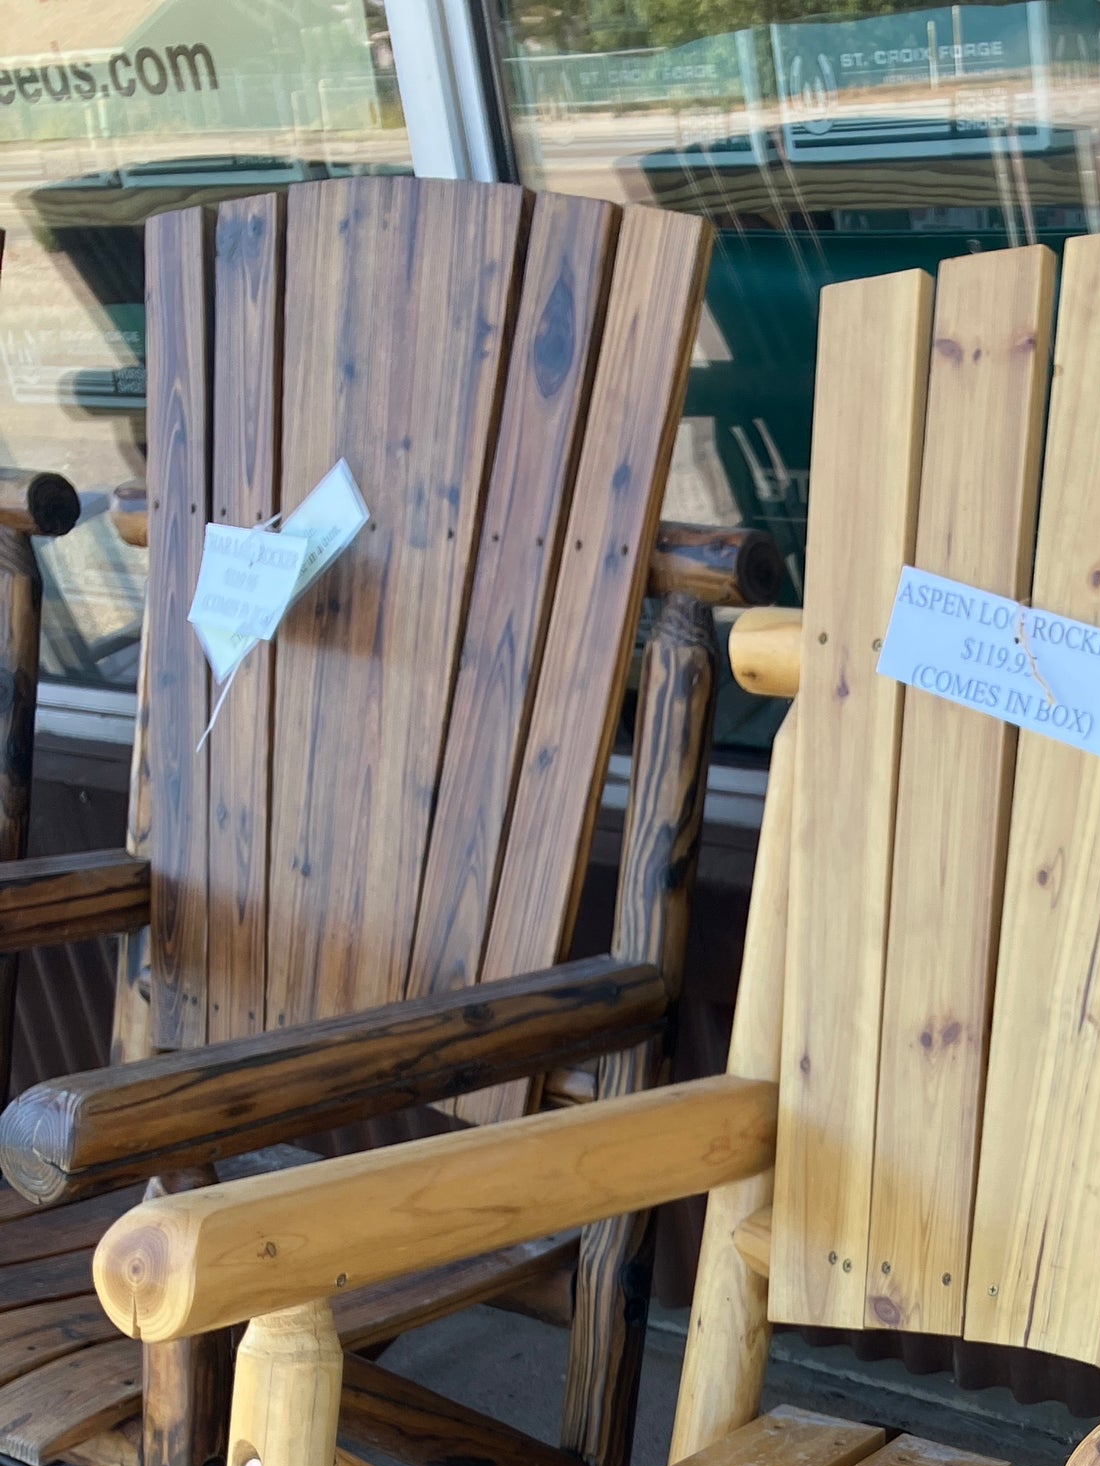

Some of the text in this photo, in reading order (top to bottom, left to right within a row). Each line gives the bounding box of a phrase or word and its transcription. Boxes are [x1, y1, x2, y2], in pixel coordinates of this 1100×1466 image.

[938, 41, 1004, 60] FORGE
[900, 582, 976, 620] ASPEN
[910, 663, 1095, 741] (COMES IN BOX)
